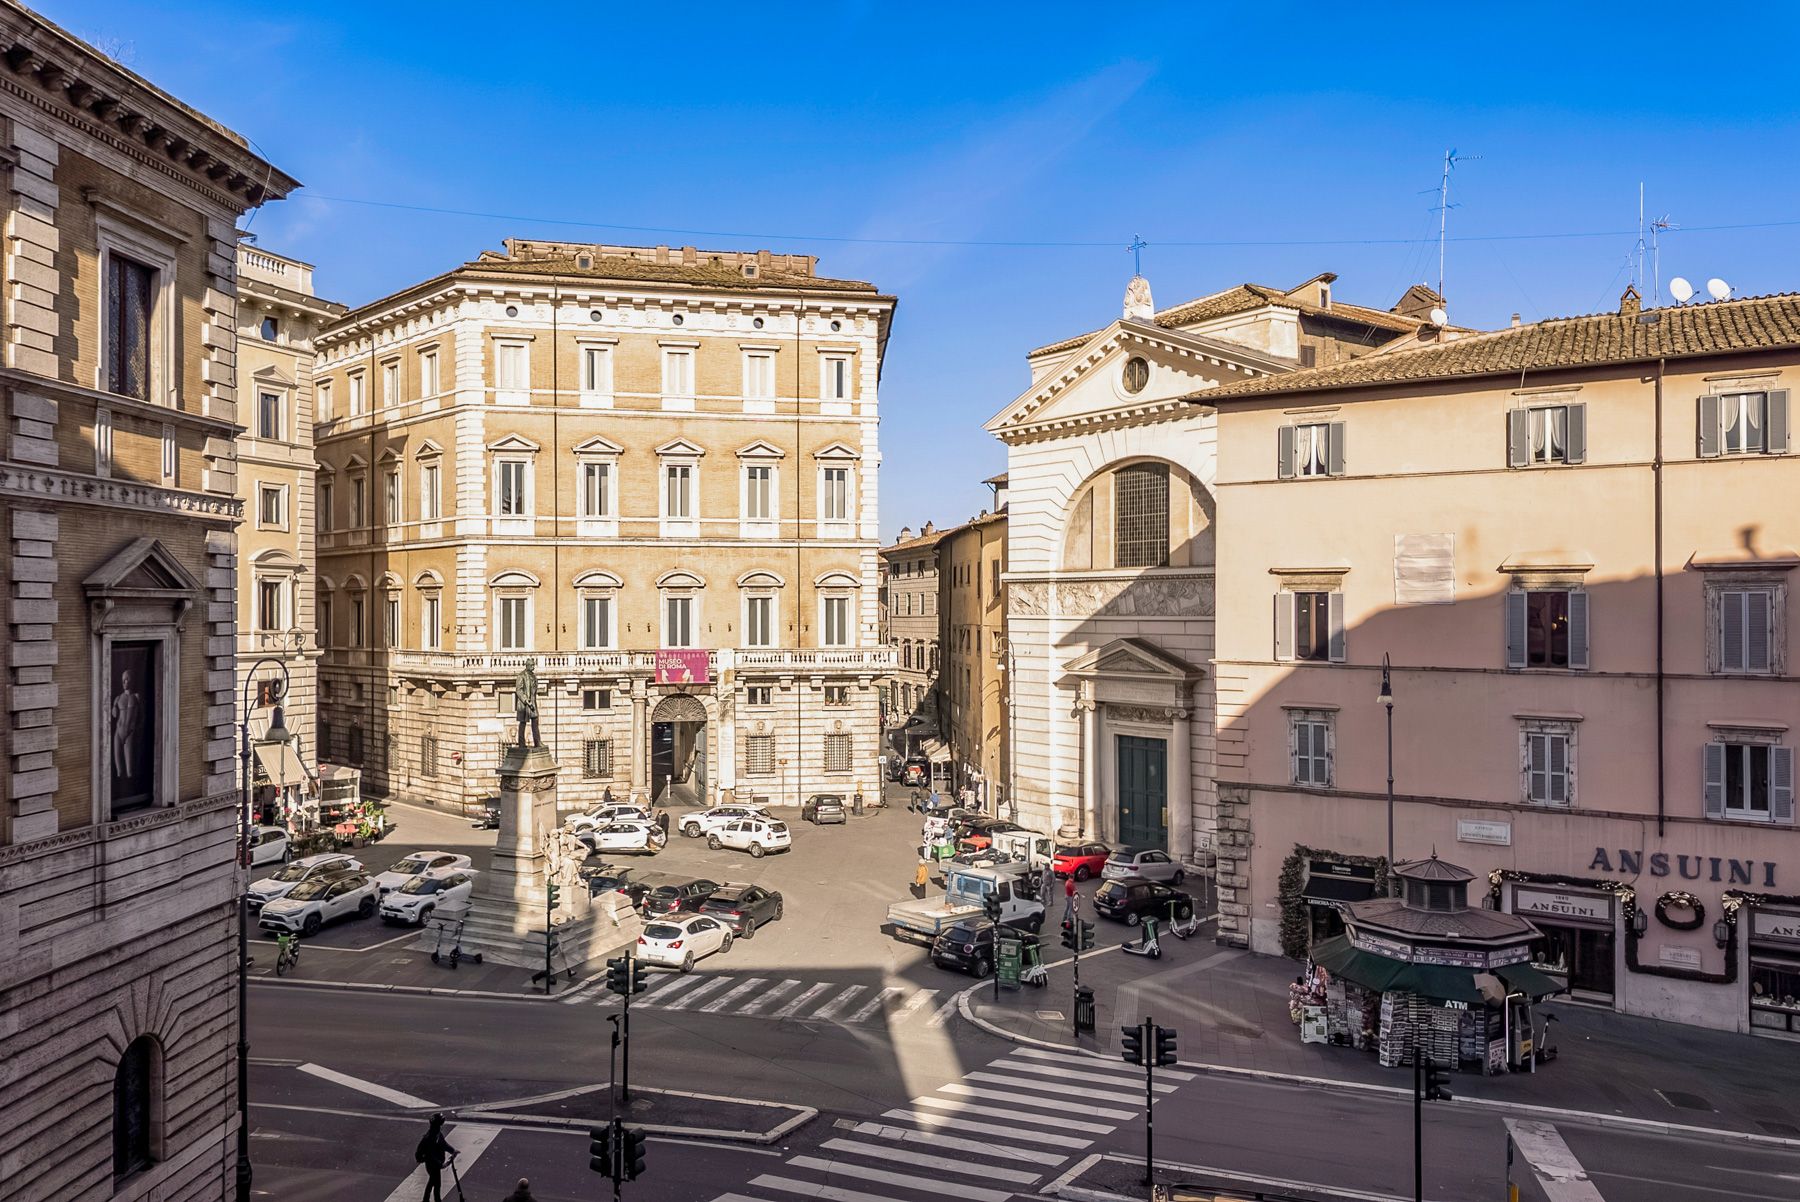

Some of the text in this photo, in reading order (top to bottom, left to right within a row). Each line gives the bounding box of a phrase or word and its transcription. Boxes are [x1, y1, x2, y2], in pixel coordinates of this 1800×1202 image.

[1588, 847, 1777, 888] ANSUINI
[1530, 902, 1595, 917] ANSUINI
[1444, 999, 1469, 1011] ATM
